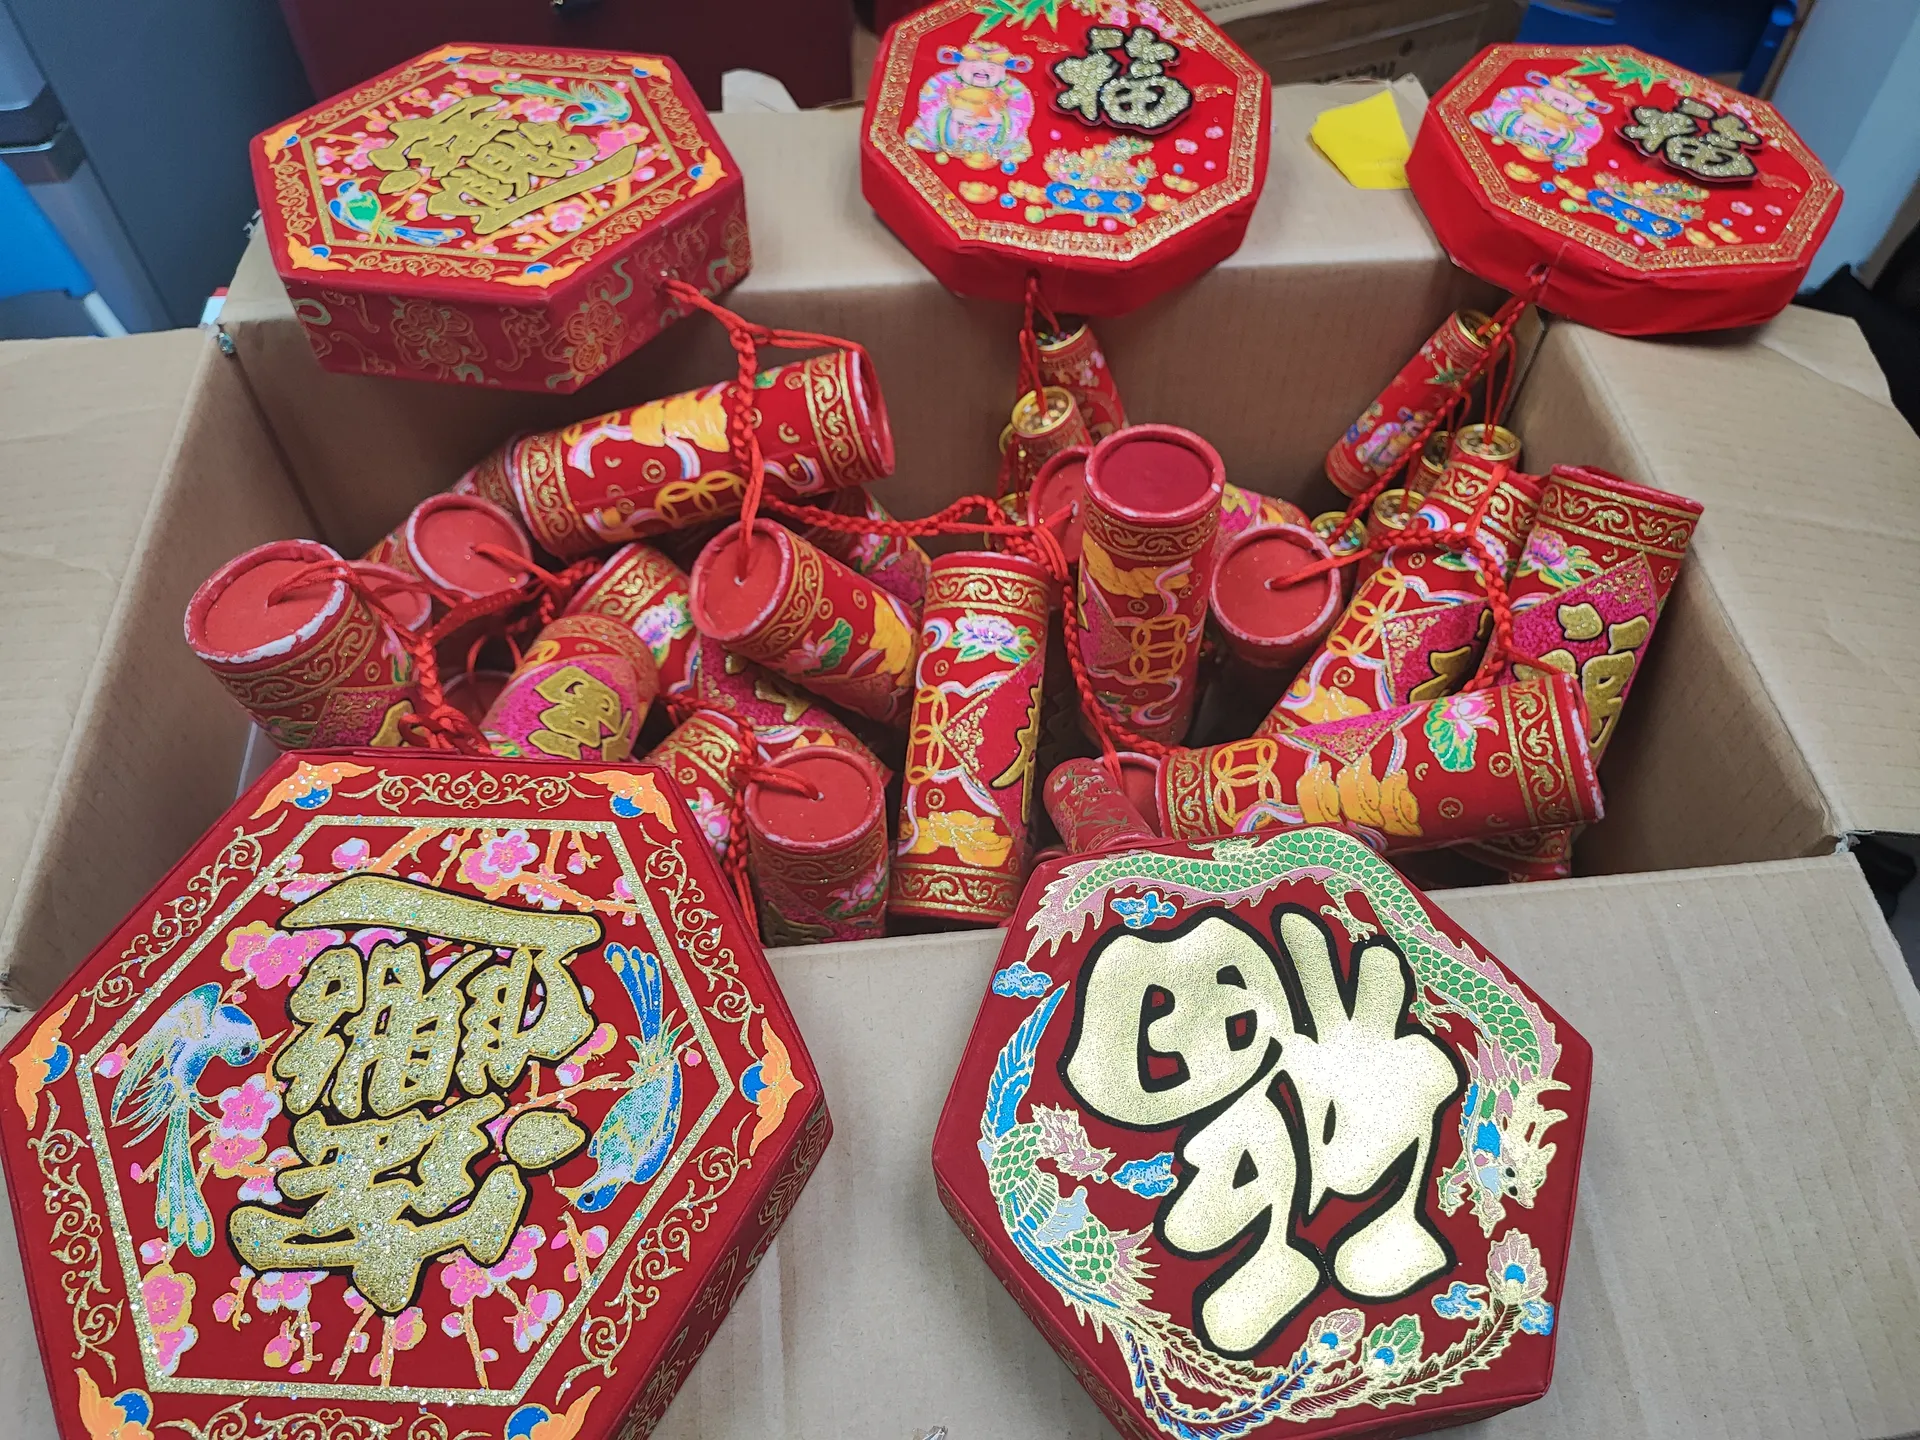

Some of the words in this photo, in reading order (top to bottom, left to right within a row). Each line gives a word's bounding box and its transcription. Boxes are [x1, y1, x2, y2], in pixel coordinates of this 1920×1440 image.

[1053, 26, 1193, 129] 福
[1622, 98, 1762, 178] 福
[1058, 906, 1465, 1358] 福
